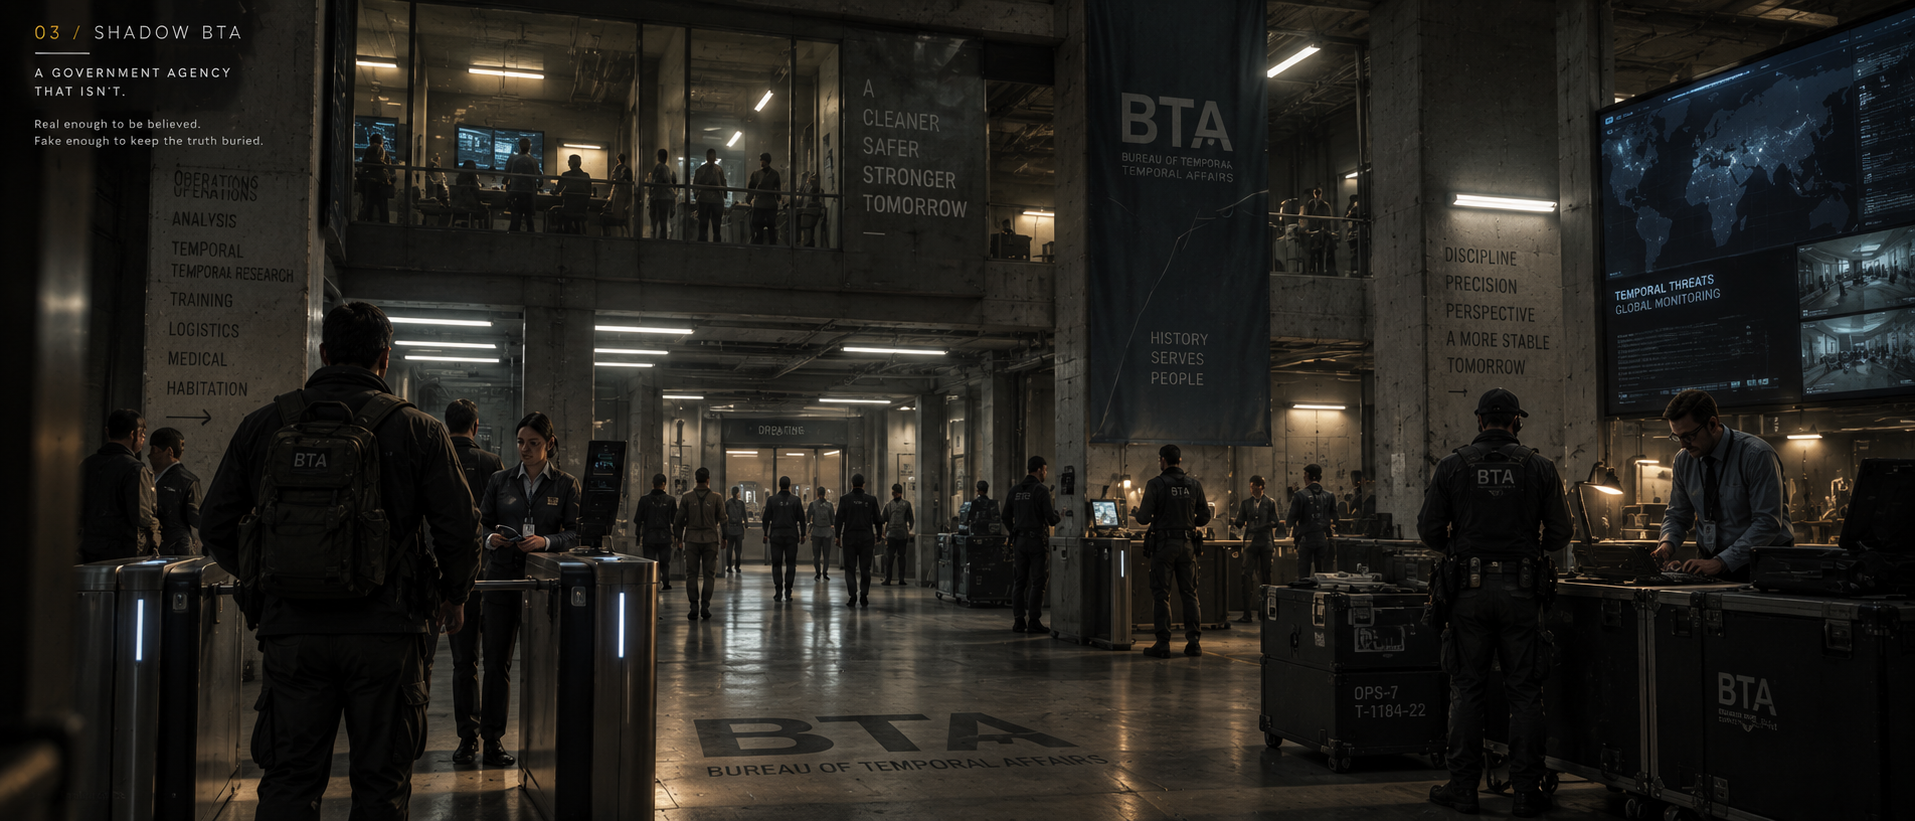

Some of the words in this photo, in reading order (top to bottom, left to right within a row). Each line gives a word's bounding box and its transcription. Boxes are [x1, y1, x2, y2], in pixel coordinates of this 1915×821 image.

[863, 79, 875, 98] A
[863, 108, 940, 132] CLEANER
[1121, 91, 1234, 152] BTA
[863, 136, 919, 158] SAFER
[1121, 152, 1162, 165] BUREAU
[1165, 155, 1178, 166] OF
[863, 165, 956, 189] STRONGER
[1122, 165, 1182, 179] TEMPORAL
[1186, 171, 1234, 183] AFFAIRS
[863, 194, 968, 218] TOMORROW
[172, 211, 237, 229] ANALYSIS
[171, 240, 244, 259] TEMPORAL
[1445, 246, 1517, 266] DISCIPLINE
[235, 266, 294, 283] RESEARCH
[1445, 274, 1517, 294] PRECISION
[1615, 283, 1667, 301] TEMPORAL
[1669, 274, 1715, 292] THREATS
[170, 291, 234, 308] TRAINING
[1615, 300, 1652, 316] GLOBAL
[1655, 288, 1721, 309] MONITORING
[1446, 303, 1535, 323] PERSPECTIVE
[169, 321, 240, 338] LOGISTICS
[1150, 331, 1209, 346] HISTORY
[1446, 330, 1456, 347] A
[1460, 331, 1498, 347] MORE
[1502, 333, 1550, 350] STABLE
[168, 350, 228, 367] MEDICAL
[1151, 350, 1205, 366] SERVES
[1447, 357, 1526, 375] TOMORROW
[1151, 371, 1204, 386] PEOPLE
[166, 380, 248, 397] HABITATION
[293, 452, 327, 468] BTA
[1477, 468, 1515, 485] BTA
[1354, 685, 1399, 701] OPS-7
[1717, 671, 1778, 717] BTA
[1354, 702, 1427, 719] T-1184-22
[692, 711, 1080, 759] BTA
[707, 762, 812, 778] BUREAU
[819, 761, 852, 774] OF
[857, 756, 1002, 774] TEMPORAL
[1002, 753, 1110, 768] AFFAIRS
